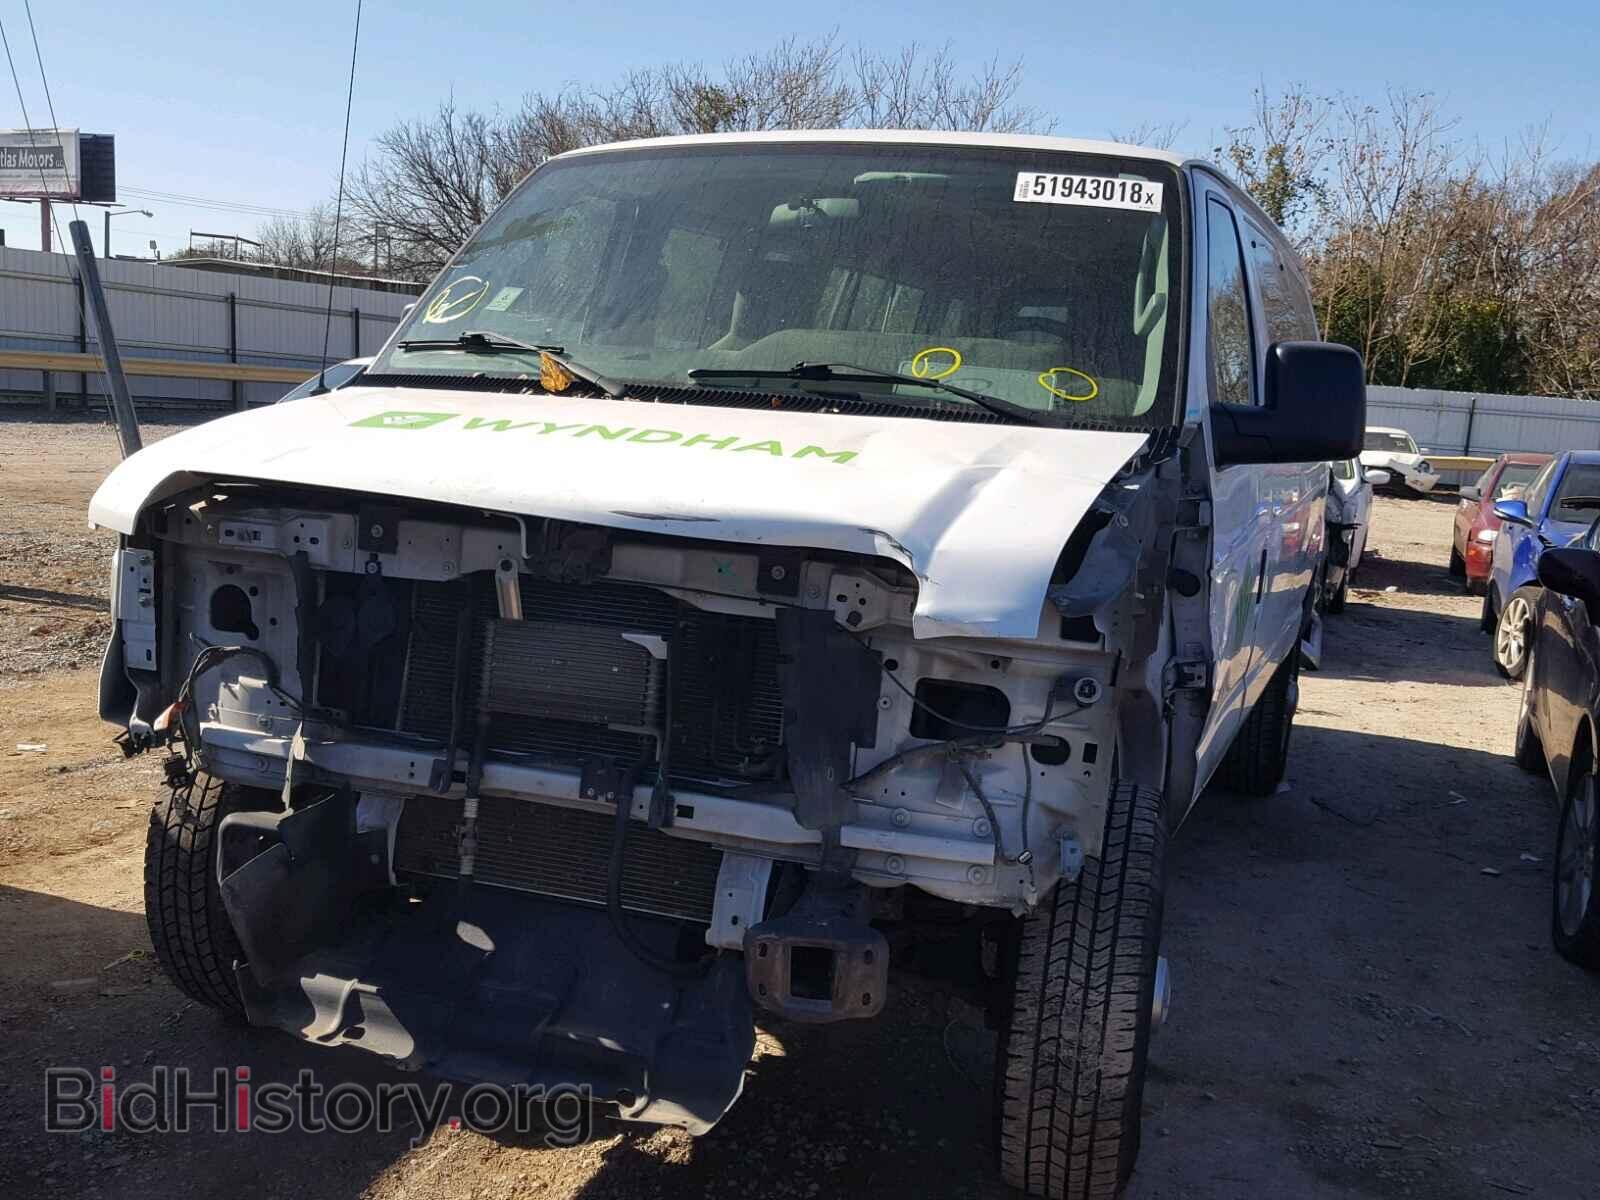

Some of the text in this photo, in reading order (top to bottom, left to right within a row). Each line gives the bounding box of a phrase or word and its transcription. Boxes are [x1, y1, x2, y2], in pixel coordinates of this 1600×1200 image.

[0, 148, 17, 168] tlas
[18, 148, 54, 168] Motors
[464, 417, 859, 464] WYNDHAM
